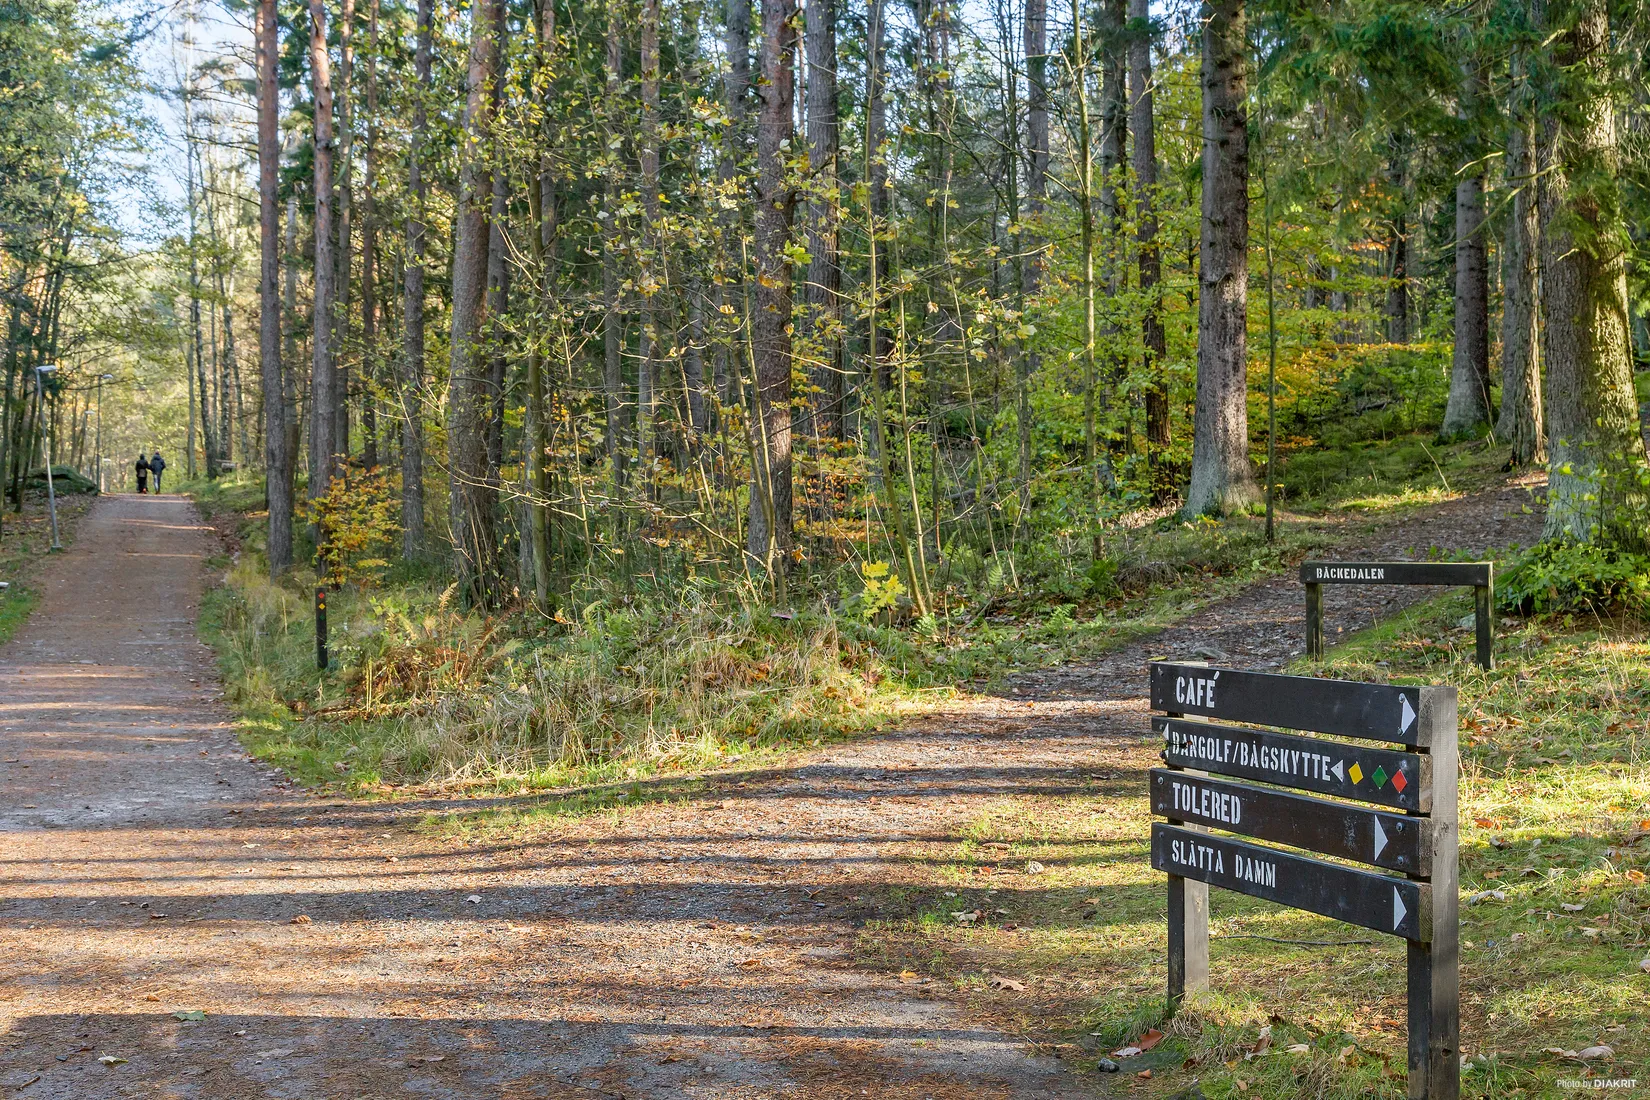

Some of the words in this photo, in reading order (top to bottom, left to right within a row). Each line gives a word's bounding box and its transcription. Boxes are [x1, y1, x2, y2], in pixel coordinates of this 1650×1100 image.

[1175, 670, 1220, 708] CAFÉ
[1172, 782, 1241, 825] TOLERED
[1171, 839, 1224, 874] SLÄTTA
[1235, 854, 1276, 888] DAMM
